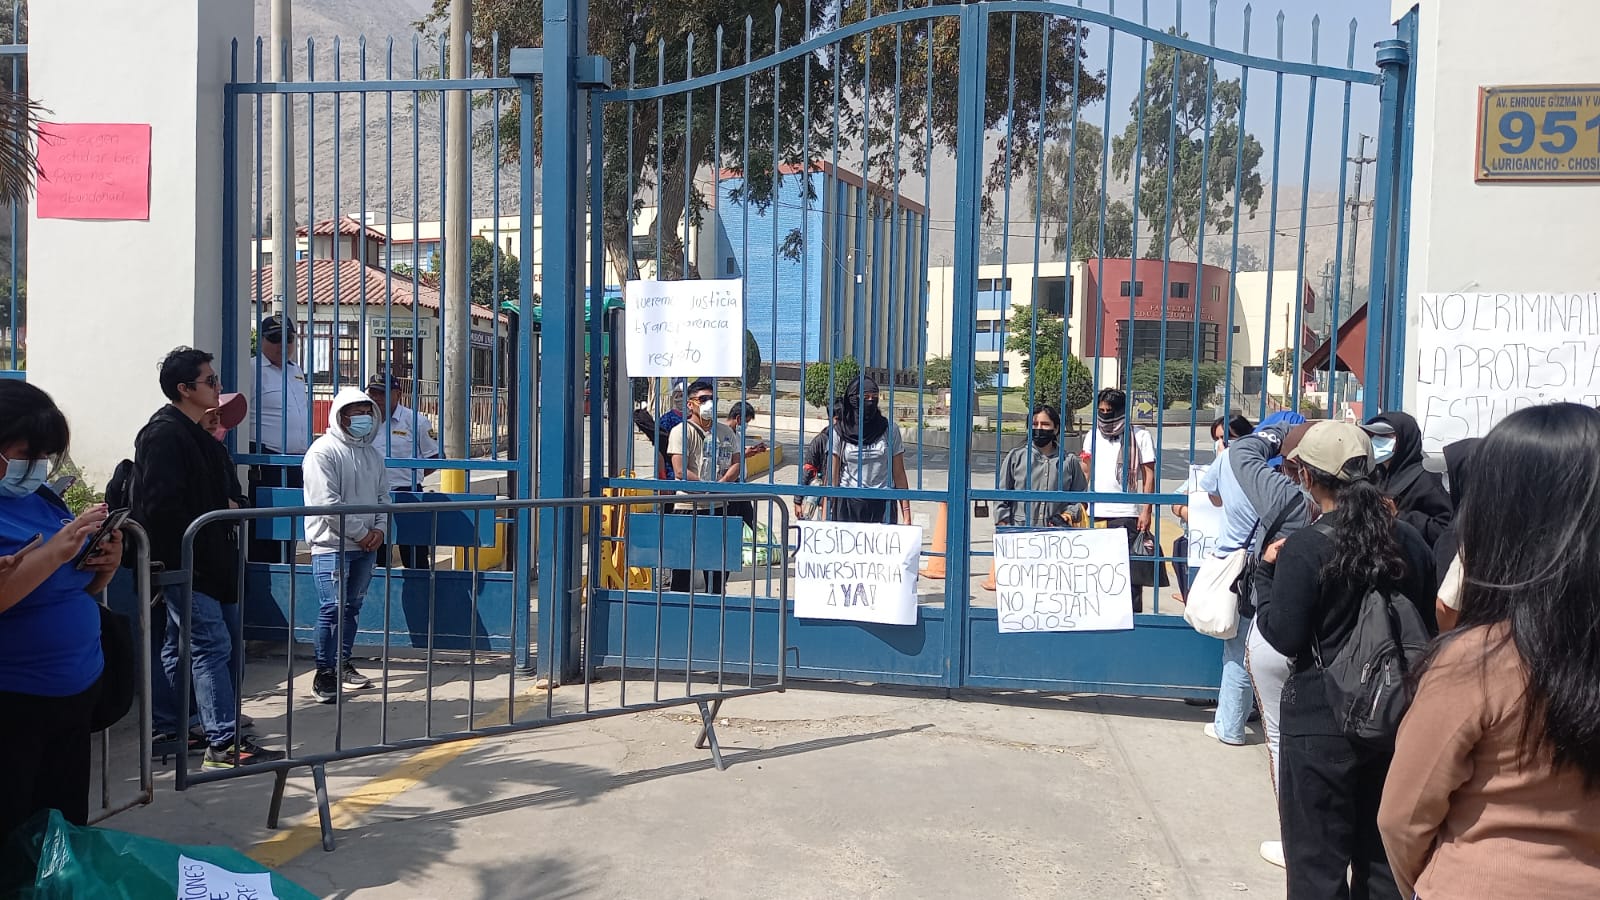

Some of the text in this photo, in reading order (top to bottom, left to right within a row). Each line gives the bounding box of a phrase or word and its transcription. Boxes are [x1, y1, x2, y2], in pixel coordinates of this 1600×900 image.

[1510, 96, 1546, 108] ENRIQUE
[1548, 95, 1583, 107] GUZMAN
[1585, 95, 1592, 107] Y
[1492, 157, 1559, 171] LURIGANCHO
[1420, 293, 1466, 331] NO
[1417, 340, 1600, 392] LA PROTESTA
[995, 533, 1091, 560] NUESTROS
[797, 561, 903, 585] UNIVERSITARIA
[996, 560, 1128, 597] COMPAÑEROS
[1000, 591, 1025, 613] NO
[1001, 613, 1077, 631] SOLOS
